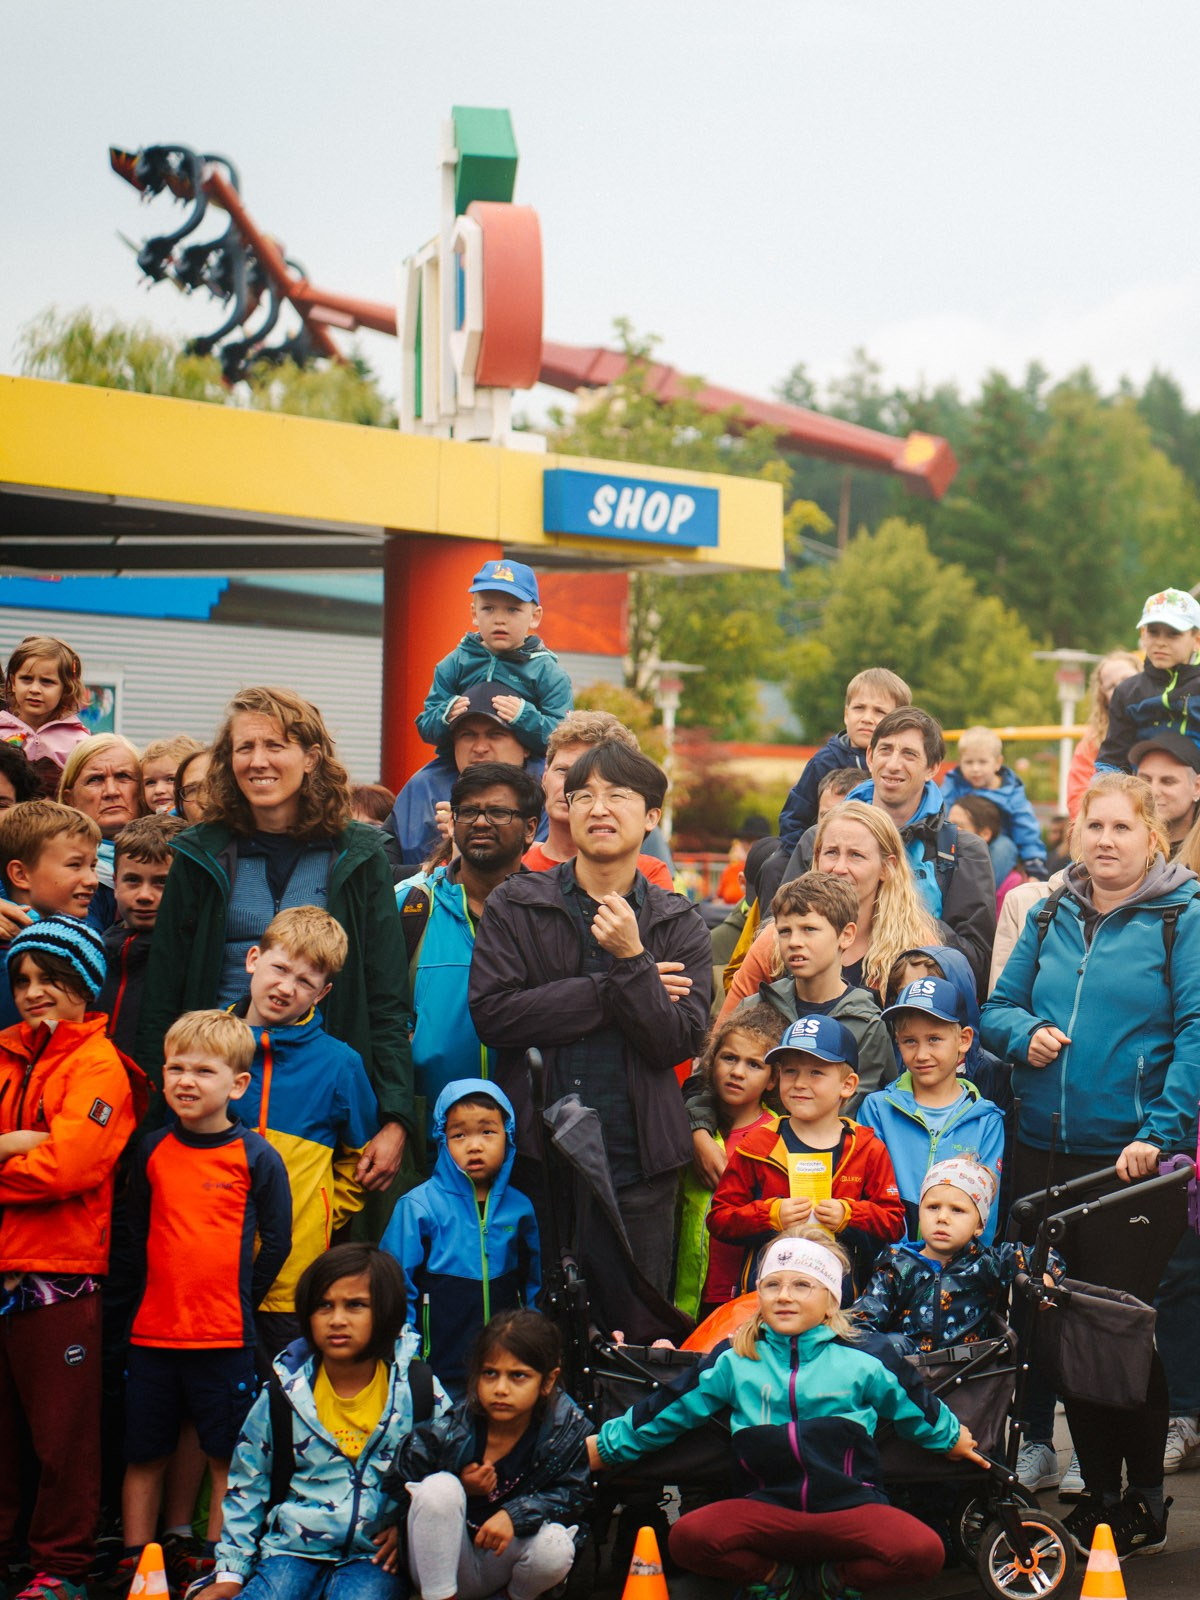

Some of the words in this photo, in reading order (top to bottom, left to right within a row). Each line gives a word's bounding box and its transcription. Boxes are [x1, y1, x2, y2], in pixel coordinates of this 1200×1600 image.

[588, 484, 696, 535] SHOP
[908, 980, 936, 995] ES
[791, 1018, 821, 1034] ES
